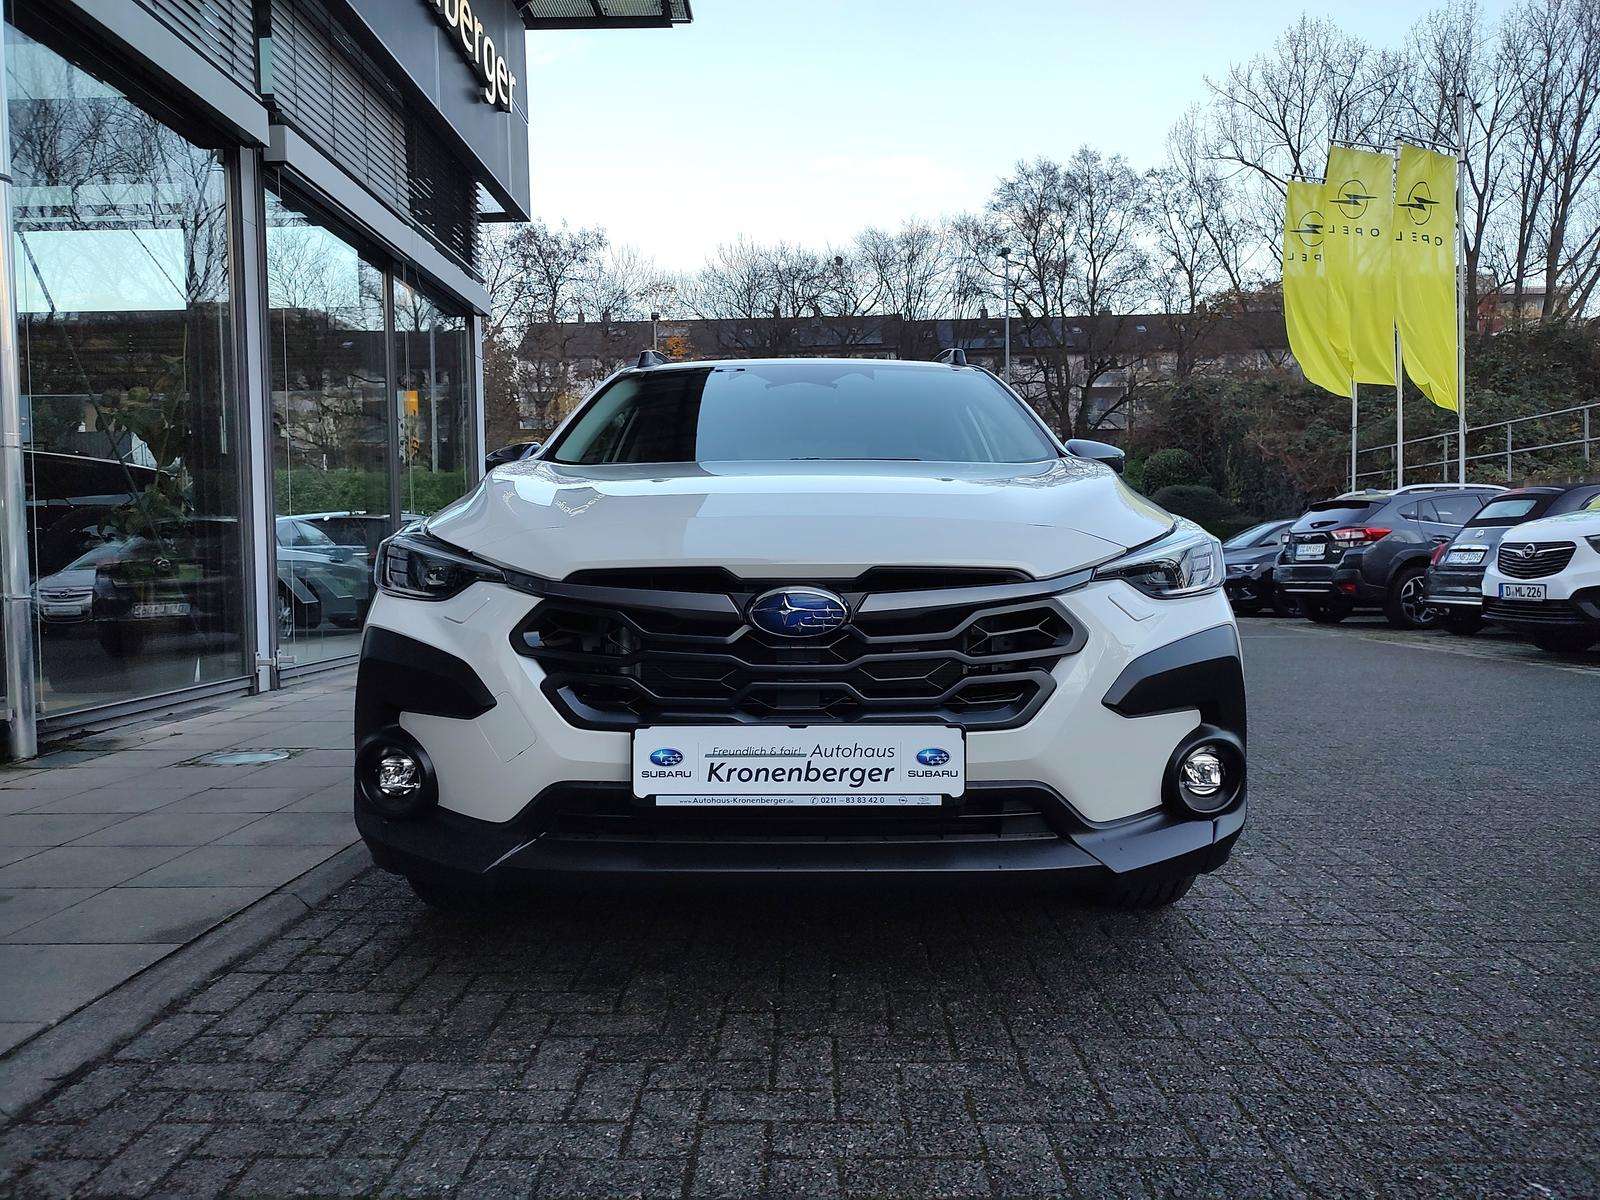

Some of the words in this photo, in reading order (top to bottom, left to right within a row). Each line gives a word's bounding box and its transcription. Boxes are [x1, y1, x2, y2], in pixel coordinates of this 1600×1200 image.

[435, 0, 517, 113] erger
[1527, 587, 1541, 597] 226
[712, 746, 767, 756] Freundlich
[810, 743, 895, 758] Autohaus
[641, 770, 692, 778] SUBARU
[707, 761, 894, 788] Kronenberger
[907, 770, 958, 778] SUBARU
[820, 796, 837, 804] 0211
